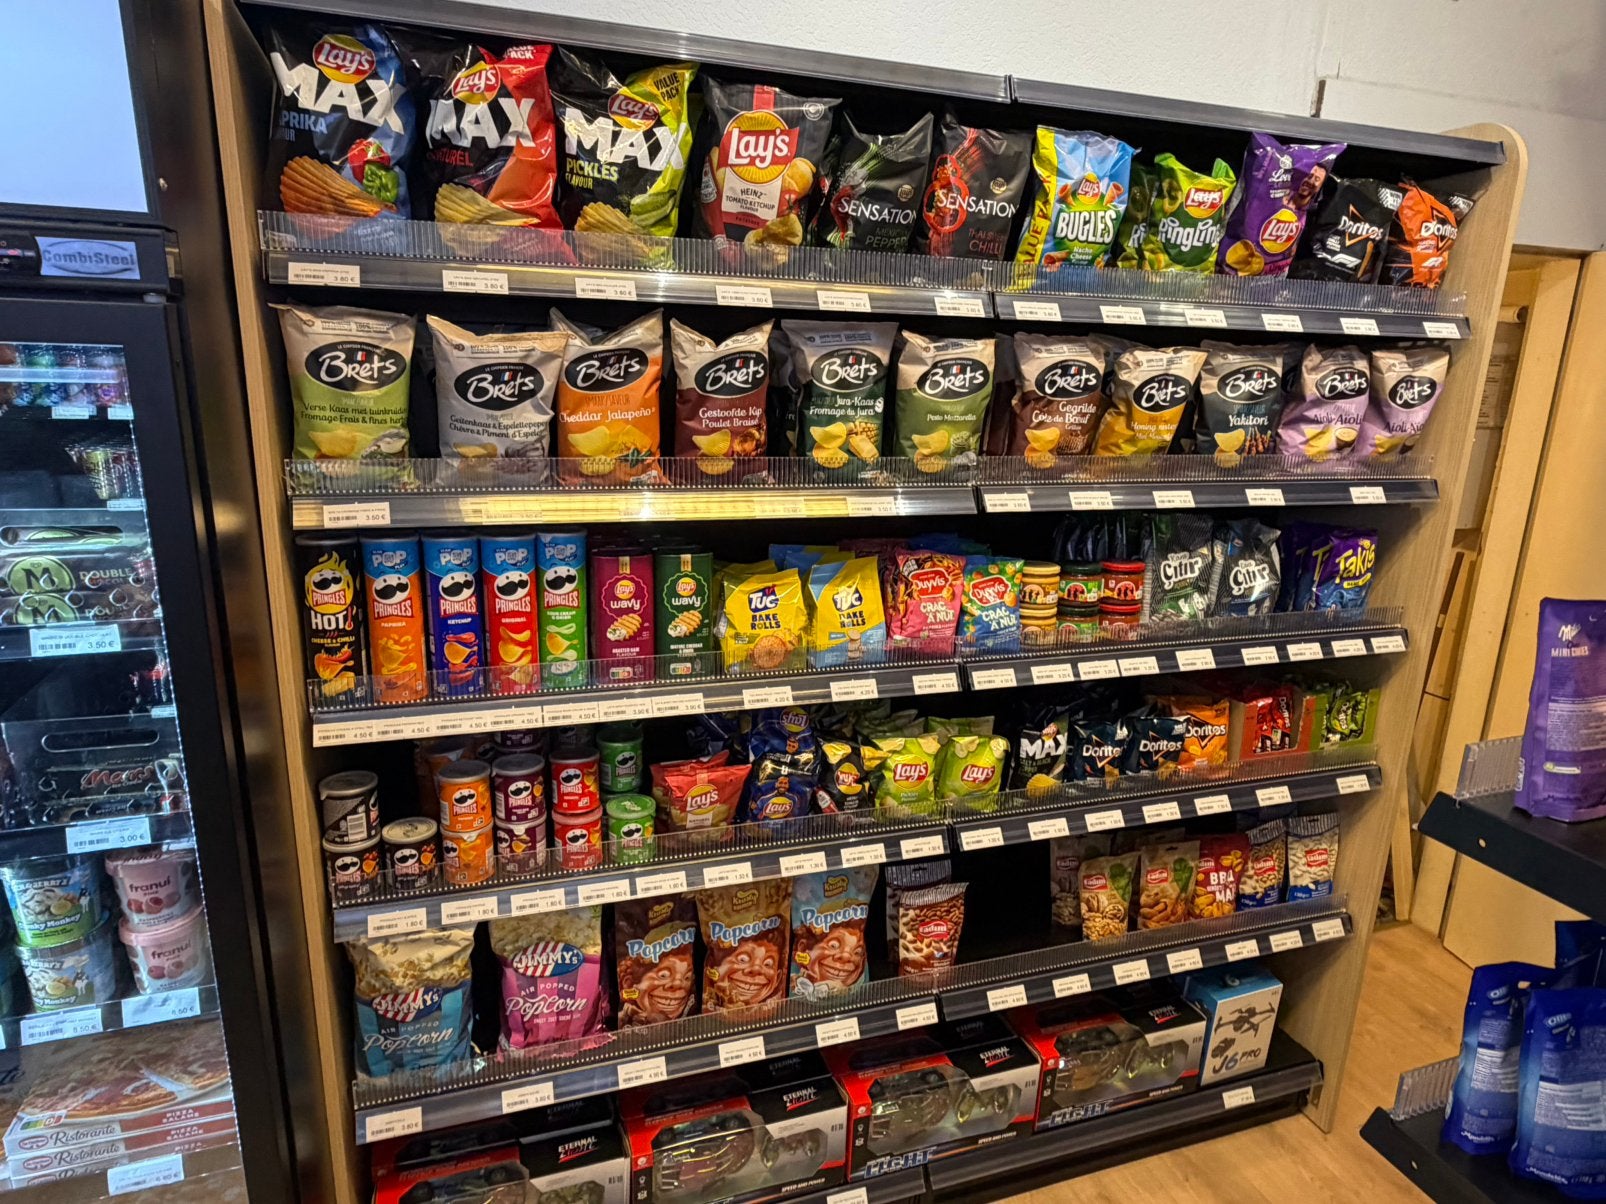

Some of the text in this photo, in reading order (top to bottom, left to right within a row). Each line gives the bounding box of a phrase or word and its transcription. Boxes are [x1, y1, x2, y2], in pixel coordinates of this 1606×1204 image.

[316, 43, 374, 74] Lay's
[455, 68, 498, 95] Lay's
[653, 72, 681, 102] VALUE PACK
[270, 52, 404, 134] MAX
[611, 94, 658, 121] Lay's
[425, 97, 536, 149] MAX
[564, 106, 684, 171] MAX
[728, 127, 791, 169] Lay's
[565, 157, 619, 184] PICKLES
[565, 173, 593, 190] FLAVOUR
[1079, 178, 1101, 197] Lay's
[740, 187, 764, 200] HEINZ
[1186, 188, 1222, 209] Lay's
[725, 195, 775, 210] TOMATO KETCHUP
[1055, 209, 1117, 244] BUGLES
[1263, 220, 1299, 244] Lay's
[1338, 215, 1384, 241] Doritos
[1420, 220, 1458, 240] Doritos
[42, 250, 136, 267] CombiSteel
[319, 351, 397, 383] Brets
[577, 357, 641, 387] Brets
[706, 359, 765, 391] Brets
[821, 357, 878, 385] Brets
[467, 372, 535, 402] Brets
[925, 368, 984, 394] Brets
[1044, 369, 1097, 393] Brets
[1225, 374, 1277, 397] Brets
[1324, 375, 1367, 395] Brets
[835, 395, 874, 407] Jura-Kaas
[1141, 386, 1186, 408] Brets
[1396, 381, 1432, 404] Brets
[304, 403, 367, 414] Verse Kaas met
[560, 408, 651, 423] Cheddar Jalapeño
[699, 406, 762, 419] Gestoofde Kip
[810, 406, 845, 417] Fromage
[855, 407, 875, 417] Jura
[1059, 401, 1097, 414] Gegrilde
[301, 411, 387, 425] Fromage Frais & fines
[450, 414, 498, 429] Geitenkaas &
[702, 417, 731, 428] Poulet
[944, 413, 977, 421] Mozzarella
[1053, 414, 1064, 423] de
[1228, 415, 1269, 427] Yakitori
[450, 422, 510, 439] Chèvre Piment
[1335, 545, 1376, 583] Takis
[22, 567, 57, 590] M
[79, 567, 133, 580] DOUBLE
[616, 584, 634, 597] Lay's
[678, 581, 696, 595] Lay's
[915, 574, 945, 594] Duyvis
[312, 591, 346, 605] PRINGLES
[440, 598, 477, 613] PRINGLES
[495, 597, 531, 613] PRINGLES
[544, 591, 579, 607] PRINGLES
[610, 599, 641, 610] wavy
[672, 596, 701, 607] wavy
[750, 591, 778, 609] TUC
[834, 592, 861, 611] TUC
[374, 600, 412, 617] PRINGLES
[920, 601, 945, 613] CRAC
[981, 607, 1009, 622] CRAC
[311, 611, 346, 630] HOT
[447, 617, 472, 625] KETCHUP
[751, 613, 781, 630] BAKE ROLLS
[87, 640, 115, 649] 3.50 €
[1279, 696, 1291, 728] Doritos
[1185, 724, 1226, 738] Doritos
[1019, 733, 1068, 760] MAX
[1139, 739, 1182, 753] Doritos
[81, 765, 154, 790] Mars
[894, 762, 928, 783] Lay's
[963, 766, 995, 784] Lay's
[560, 783, 583, 795] PRINGLES
[687, 789, 719, 809] Lay's
[453, 804, 477, 816] PRINGLES
[765, 802, 793, 819] Lay's
[119, 833, 145, 843] 3.00 €
[129, 876, 171, 893] franui
[1210, 869, 1235, 885] BBQ
[47, 913, 81, 929] Monkey
[800, 905, 868, 933] Popcorn
[710, 916, 780, 946] Popcorn
[151, 940, 191, 960] franui
[626, 927, 696, 962] Popcorn
[520, 982, 576, 998] AIR POPPED
[505, 996, 588, 1023] Popcorn
[400, 1020, 440, 1032] POPPED
[363, 1027, 454, 1055] Popcorn
[1212, 1048, 1262, 1075] J6 PRO
[783, 1086, 818, 1101] ETERNAL
[162, 1113, 200, 1124] SALAME
[166, 1108, 194, 1118] PIZZA
[50, 1125, 116, 1146] Ristorante
[166, 1130, 204, 1141] SALAME
[171, 1126, 198, 1136] PIZZA
[558, 1136, 598, 1152] ETERNAL
[54, 1144, 120, 1166] Ristorante
